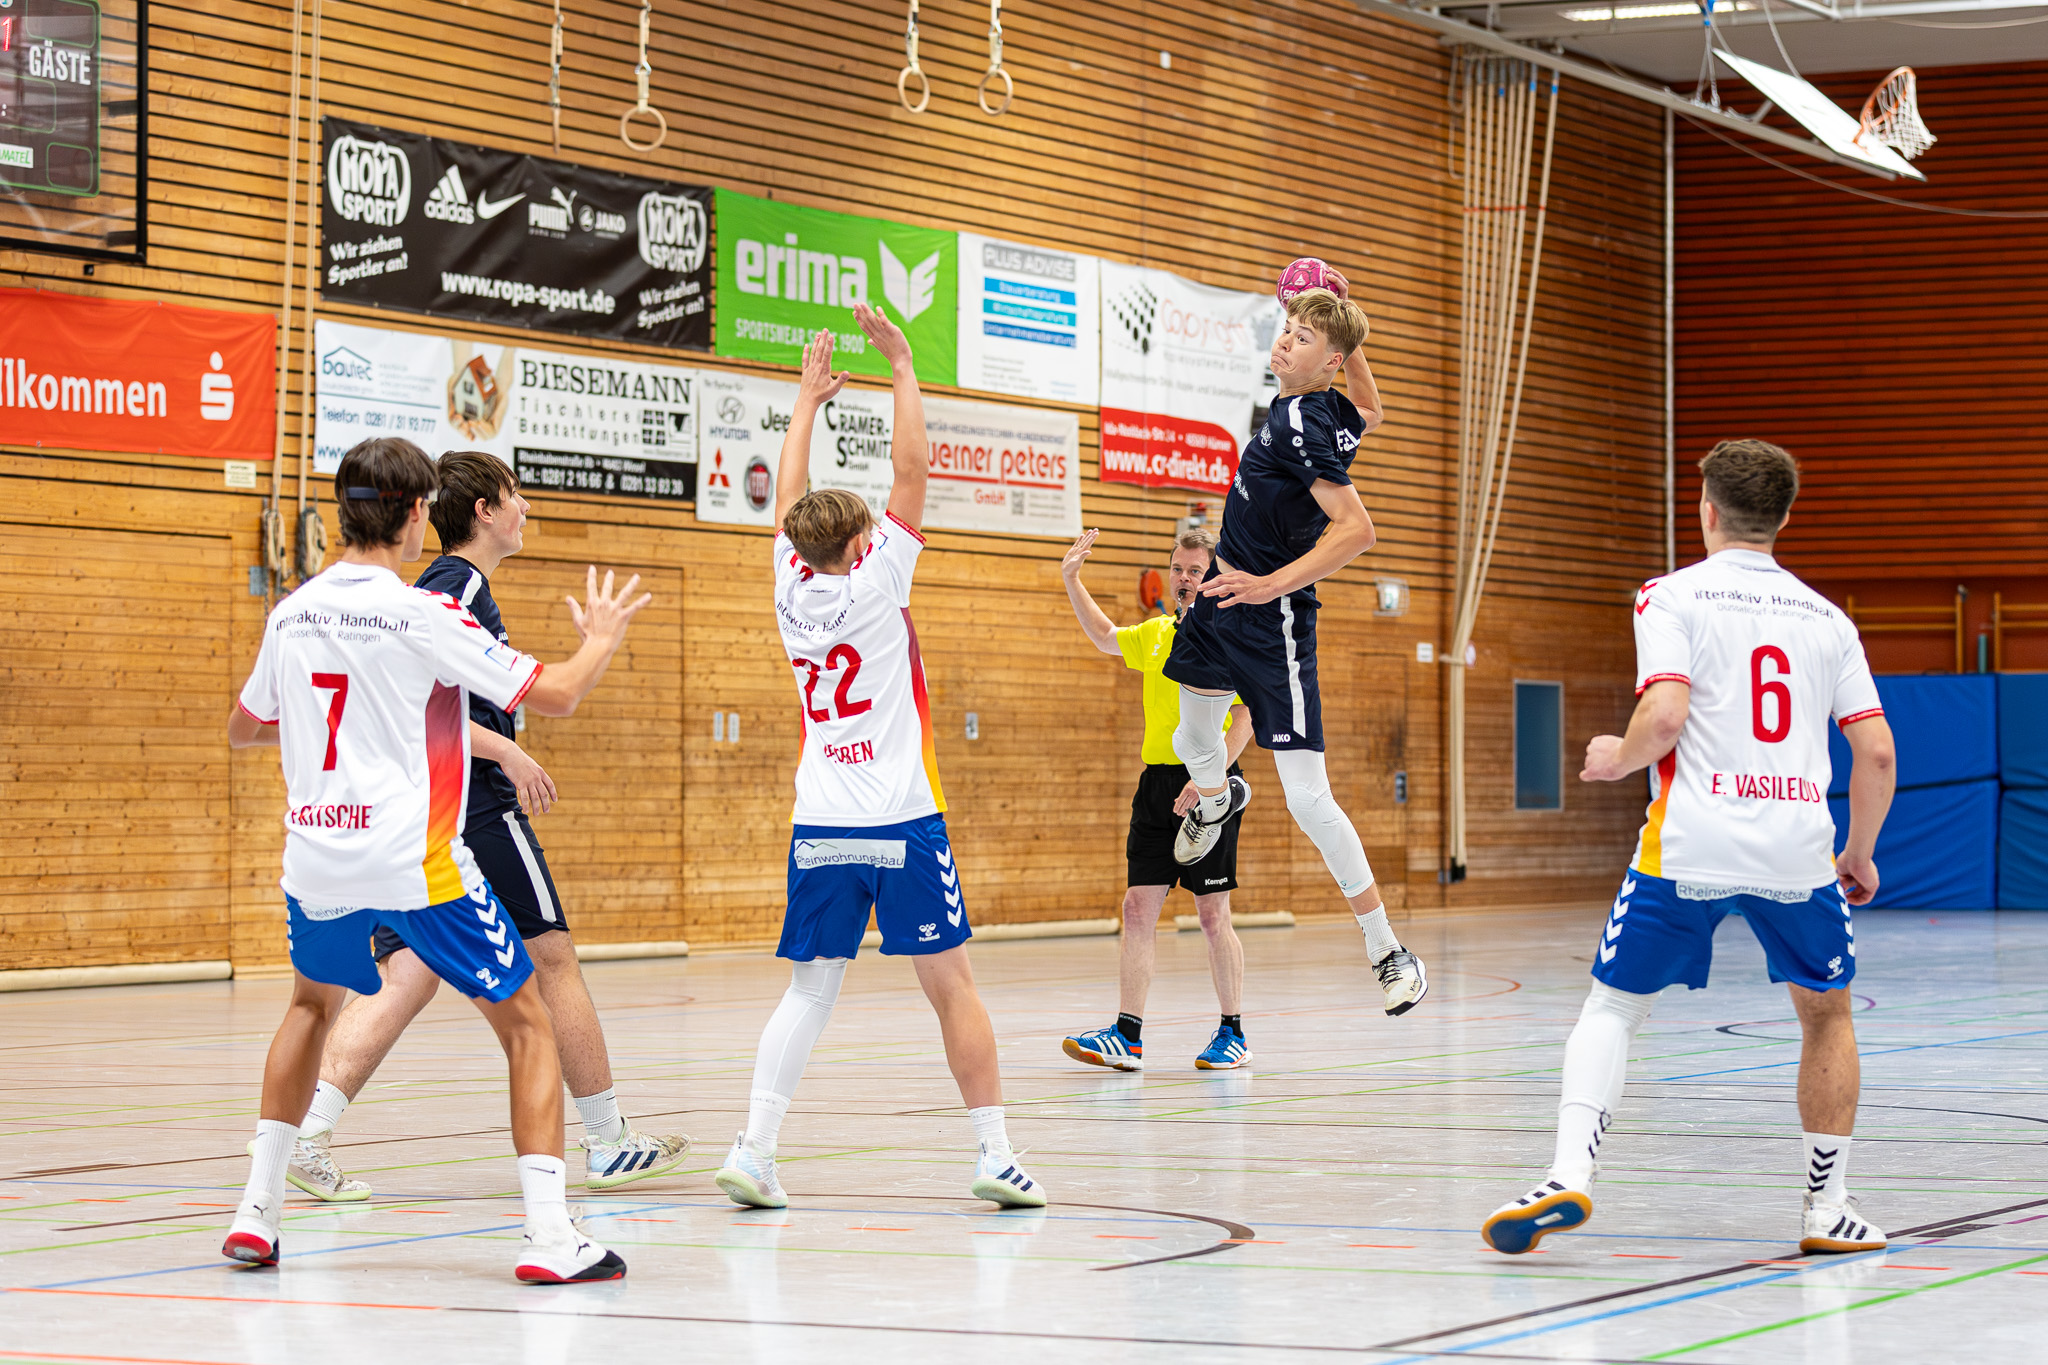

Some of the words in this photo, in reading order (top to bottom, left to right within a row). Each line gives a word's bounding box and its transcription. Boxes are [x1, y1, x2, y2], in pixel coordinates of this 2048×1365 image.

[29, 40, 91, 85] GÄSTE
[343, 192, 397, 227] SPORT
[424, 200, 475, 224] adidas
[595, 210, 626, 233] JAKO
[329, 241, 357, 261] Wir
[359, 234, 403, 256] ziehen
[651, 245, 697, 273] SPORT
[984, 247, 1022, 271] PLUS
[328, 258, 385, 286] Sportler
[385, 251, 409, 272] an!
[736, 232, 868, 309] erima
[441, 272, 616, 314] www.ropa-sport.de
[639, 290, 662, 307] Wir
[736, 318, 804, 346] SPORTSWEAR
[521, 359, 692, 404] BIESEMANN
[322, 406, 359, 424] Telefon
[762, 405, 793, 432] Jee
[520, 418, 641, 446] Bestattungen
[518, 466, 540, 484] Tel.:
[1001, 445, 1066, 485] peters
[1104, 449, 1230, 486] www.cr-direkt.de
[792, 643, 872, 723] 22
[1751, 644, 1791, 744] 6
[312, 672, 348, 771] 7
[1272, 734, 1291, 743] JAKO
[1712, 773, 1727, 795] E.
[796, 852, 904, 867] Rheinwohnungsbau
[1204, 876, 1229, 886] Kempa
